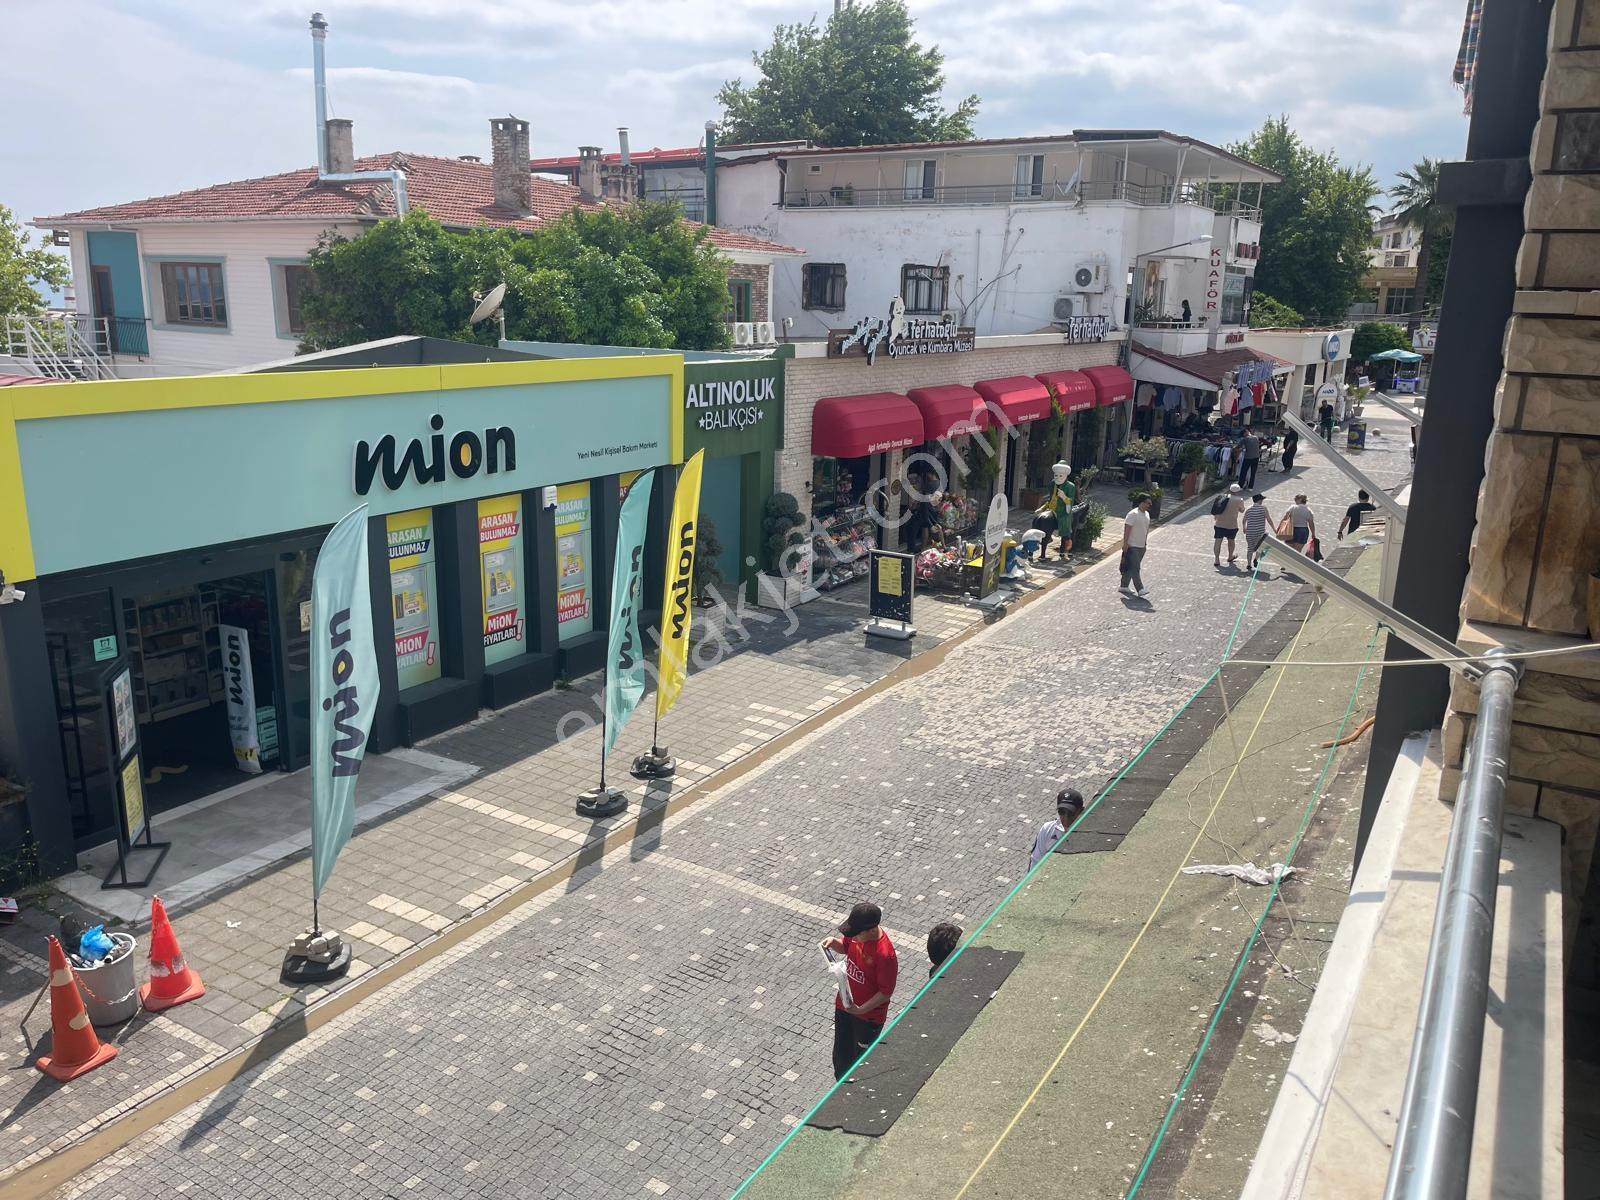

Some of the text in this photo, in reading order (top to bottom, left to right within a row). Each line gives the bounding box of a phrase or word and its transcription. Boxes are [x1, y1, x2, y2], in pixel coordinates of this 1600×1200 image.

[1206, 248, 1221, 310] KUAFÖR
[888, 342, 918, 359] Oyuncak
[918, 344, 927, 354] ve
[927, 340, 953, 354] Kumbara
[685, 376, 776, 409] ALTINOLUK
[705, 407, 758, 431] BALIKÇISI
[352, 413, 516, 496] mion
[577, 450, 590, 460] Yeni
[590, 448, 604, 458] Nesil
[604, 445, 622, 457] Kişisel
[639, 441, 658, 450] Marketi
[481, 513, 513, 529] ARASAN
[480, 525, 516, 542] BULUNMAZ
[388, 541, 427, 558] ULUNMAZ
[671, 521, 693, 639] mion
[223, 633, 244, 705] mion
[322, 607, 366, 778] mion
[847, 963, 865, 981] AIG
